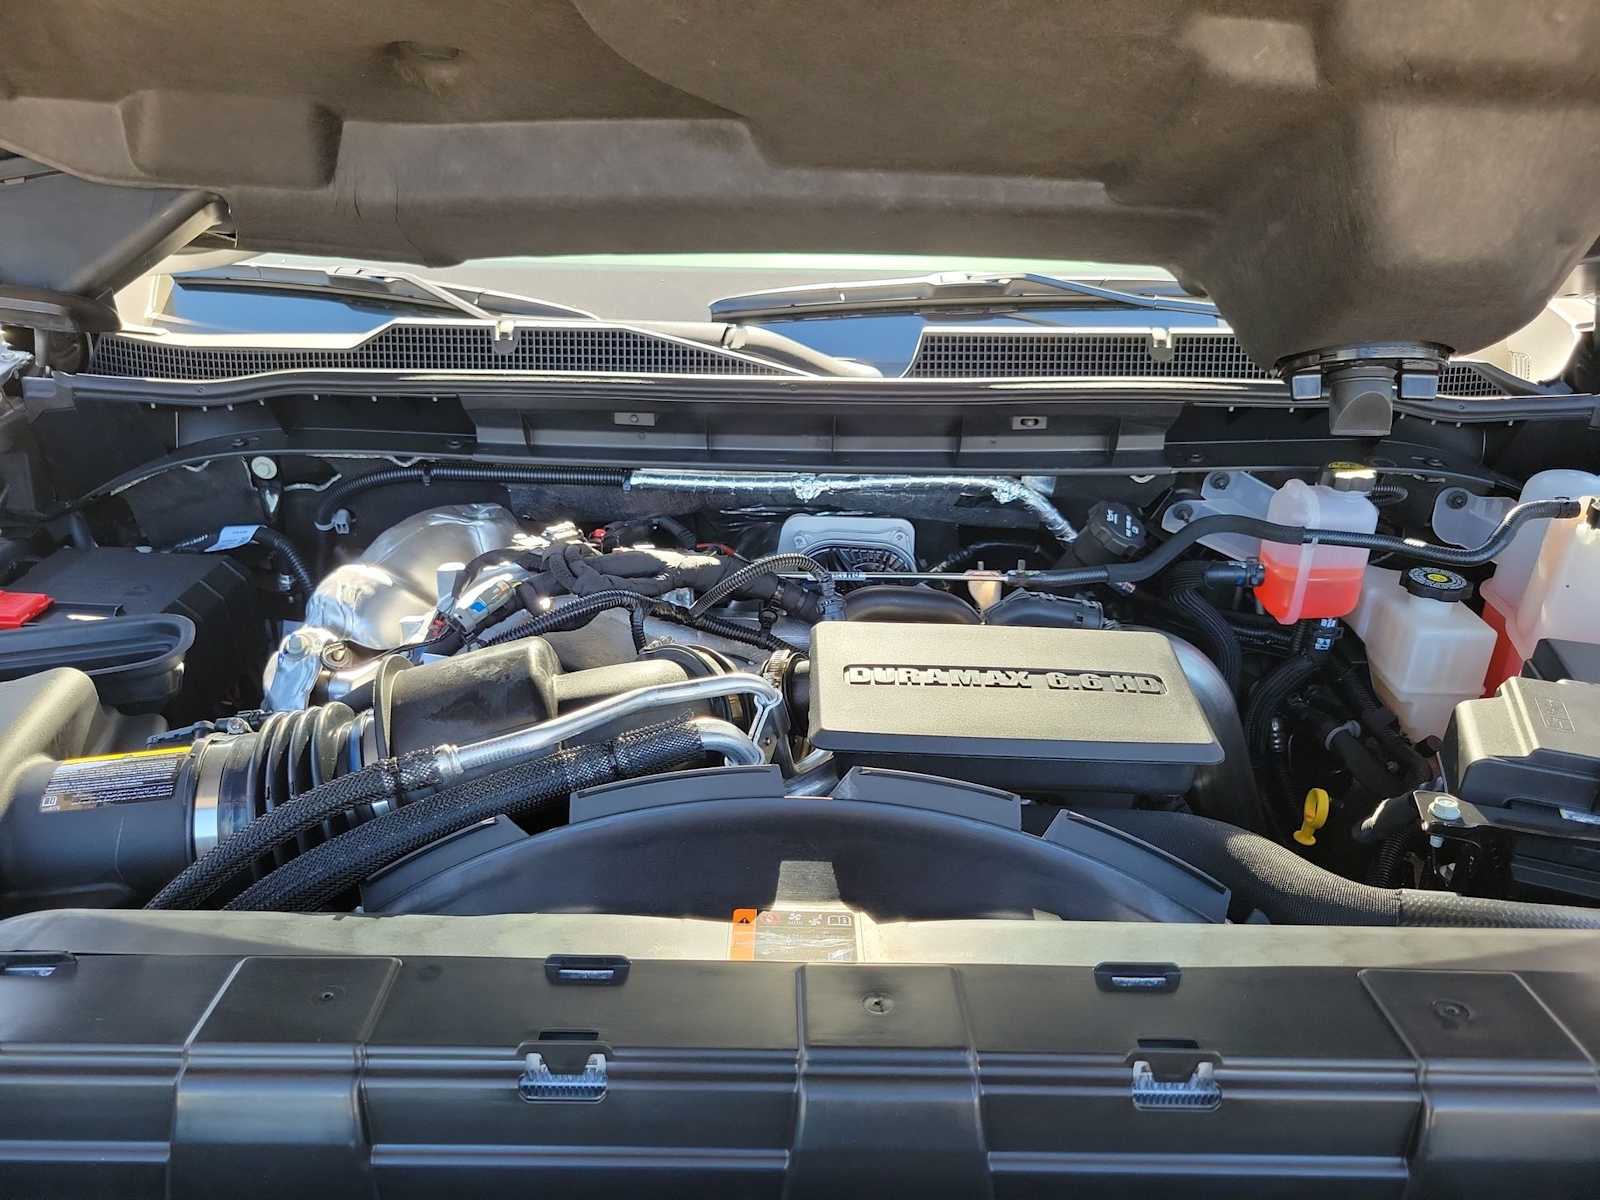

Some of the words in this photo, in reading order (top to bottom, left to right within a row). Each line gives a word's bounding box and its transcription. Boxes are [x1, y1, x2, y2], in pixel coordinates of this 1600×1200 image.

[847, 667, 1032, 689] DURAMAX
[1045, 672, 1103, 691] 6.6
[1110, 675, 1163, 695] HD
